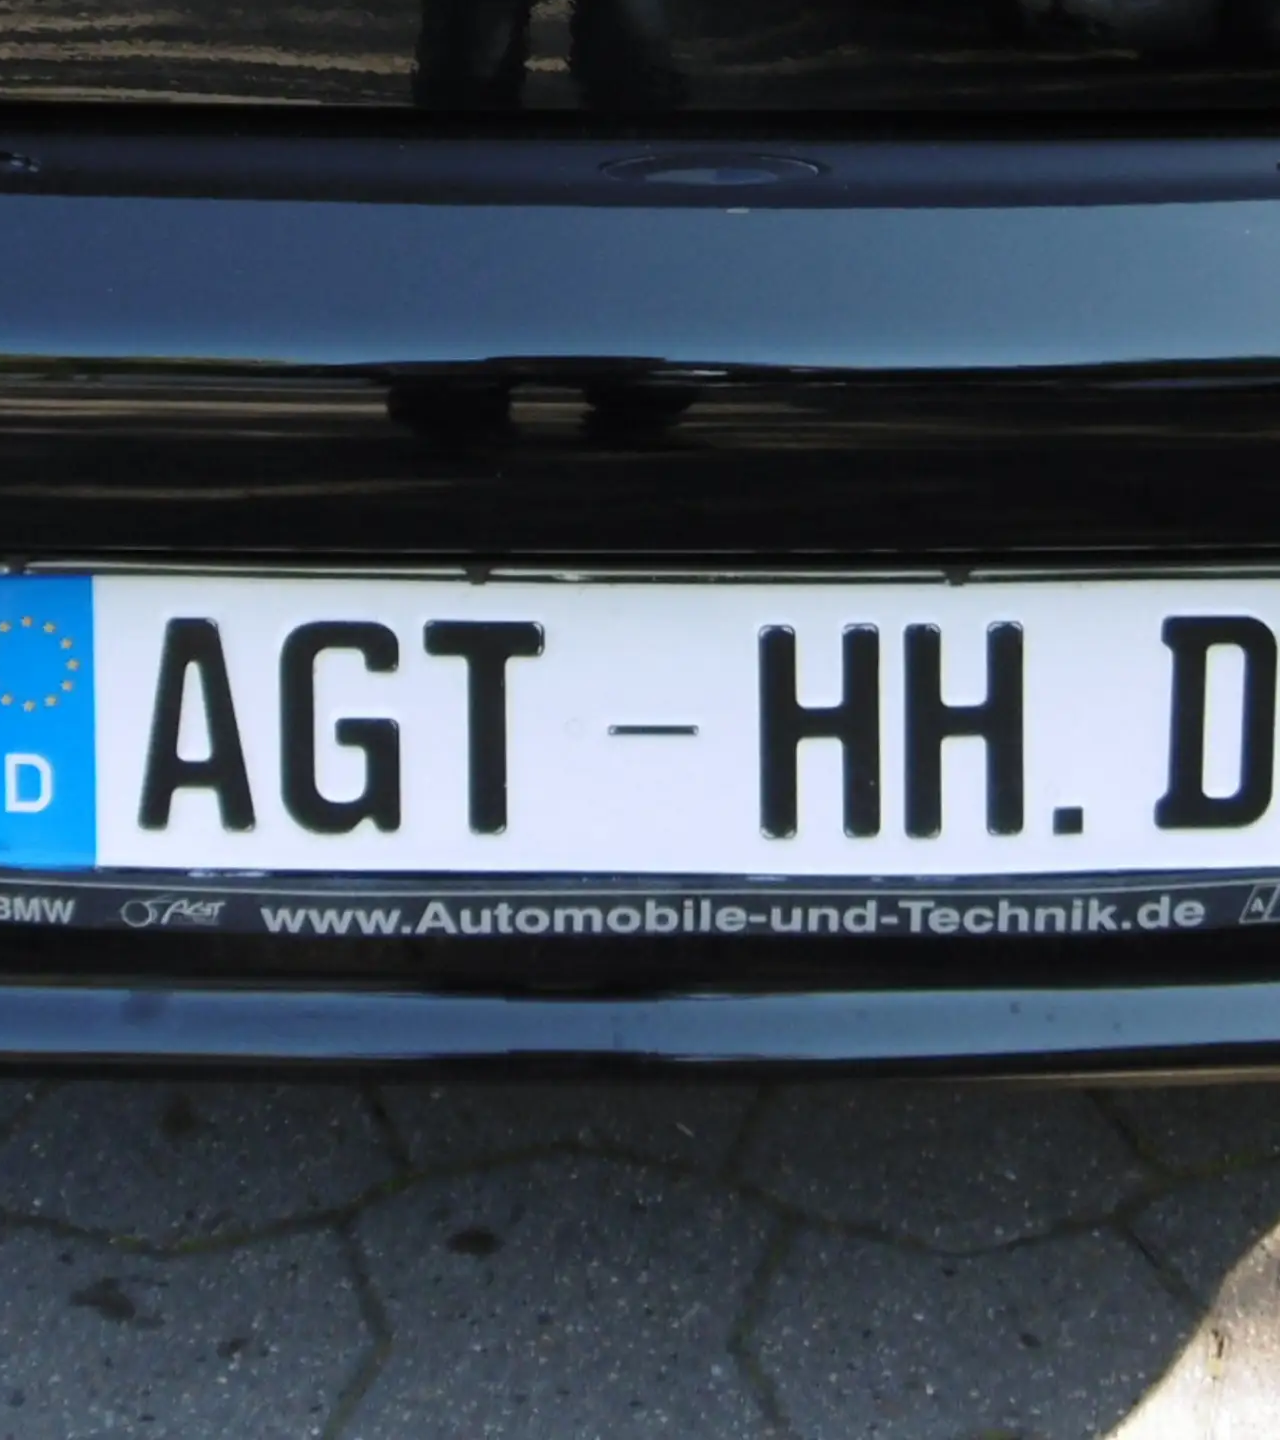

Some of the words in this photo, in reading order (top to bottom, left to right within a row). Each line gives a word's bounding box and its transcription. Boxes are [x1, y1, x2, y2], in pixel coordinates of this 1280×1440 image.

[137, 616, 545, 833] AGT
[5, 753, 53, 813] D
[260, 899, 1206, 934] www.Automobile-und-Technik.de
